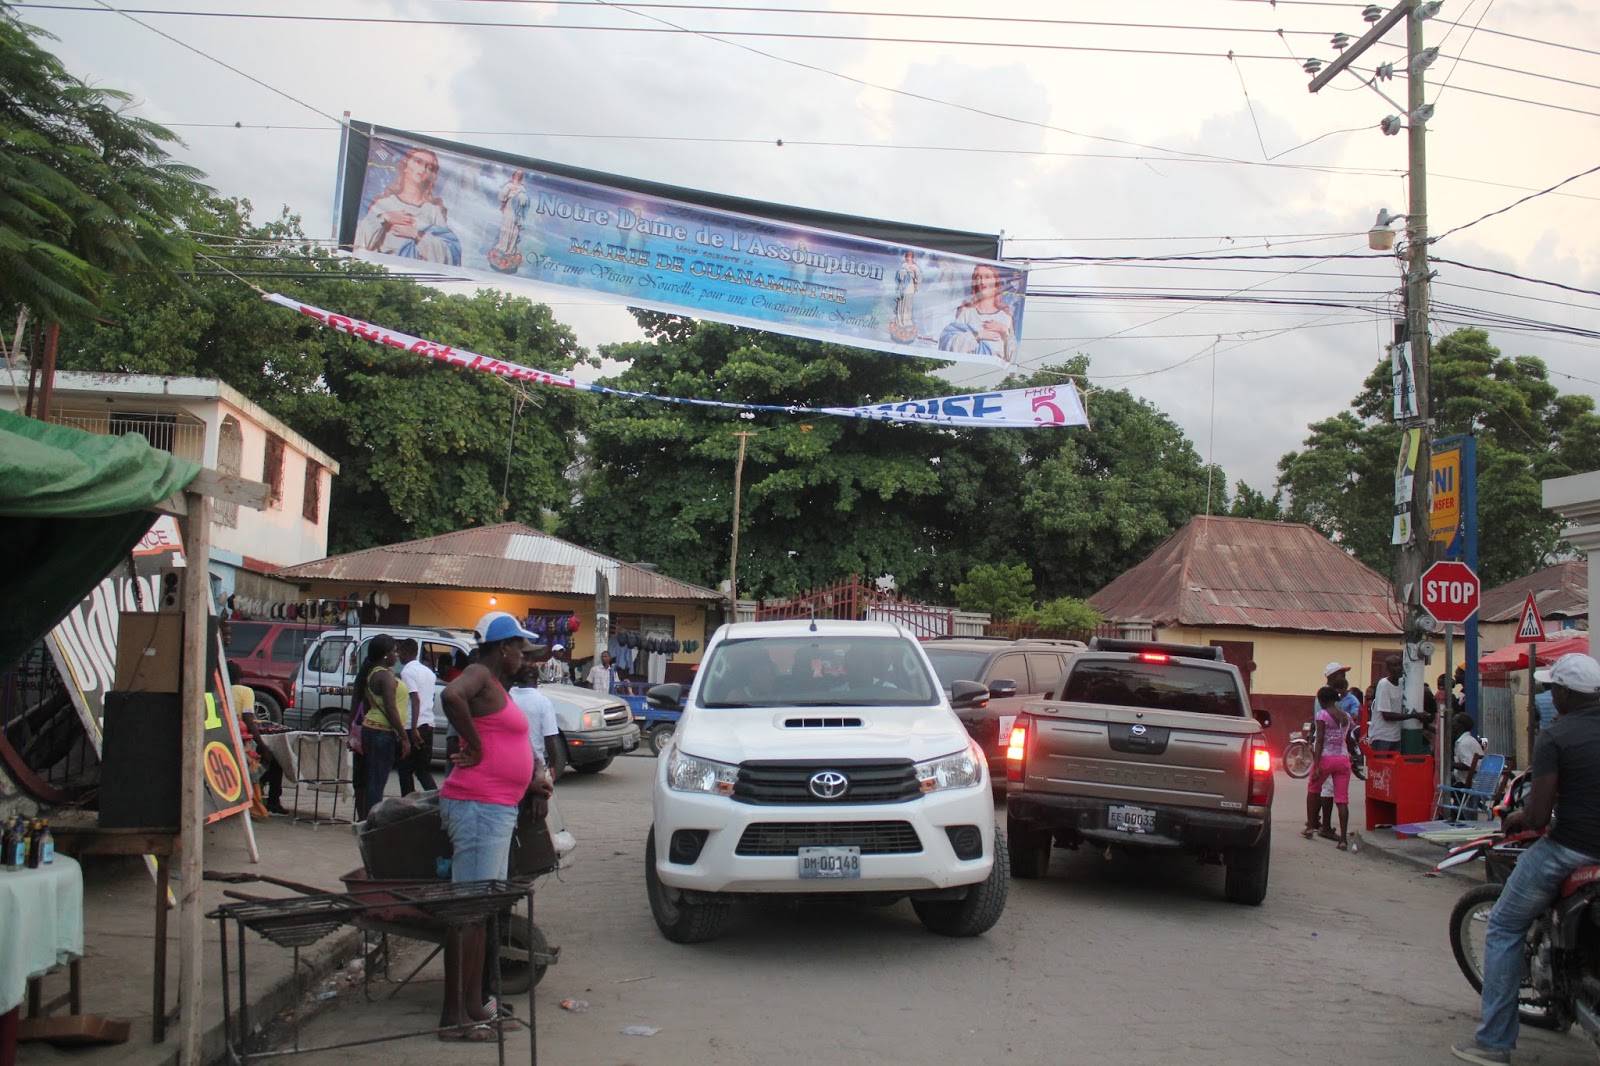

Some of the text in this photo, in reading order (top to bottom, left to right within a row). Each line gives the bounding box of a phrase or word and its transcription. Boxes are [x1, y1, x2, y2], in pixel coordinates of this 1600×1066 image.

[536, 190, 609, 226] Notre
[617, 207, 687, 241] Dame
[695, 225, 724, 248] de
[526, 252, 558, 272] Vers
[563, 263, 584, 276] une
[591, 263, 634, 285] Vision
[698, 289, 725, 301] pour
[727, 293, 747, 305] une
[751, 294, 825, 318] Ouanaminthe
[829, 309, 880, 330] Nouvelle
[570, 237, 847, 304] MAIRIE DE OUANAMINTHE
[1432, 466, 1453, 494] NI
[1427, 580, 1475, 603] STOP
[1065, 763, 1208, 786] FRONTIER
